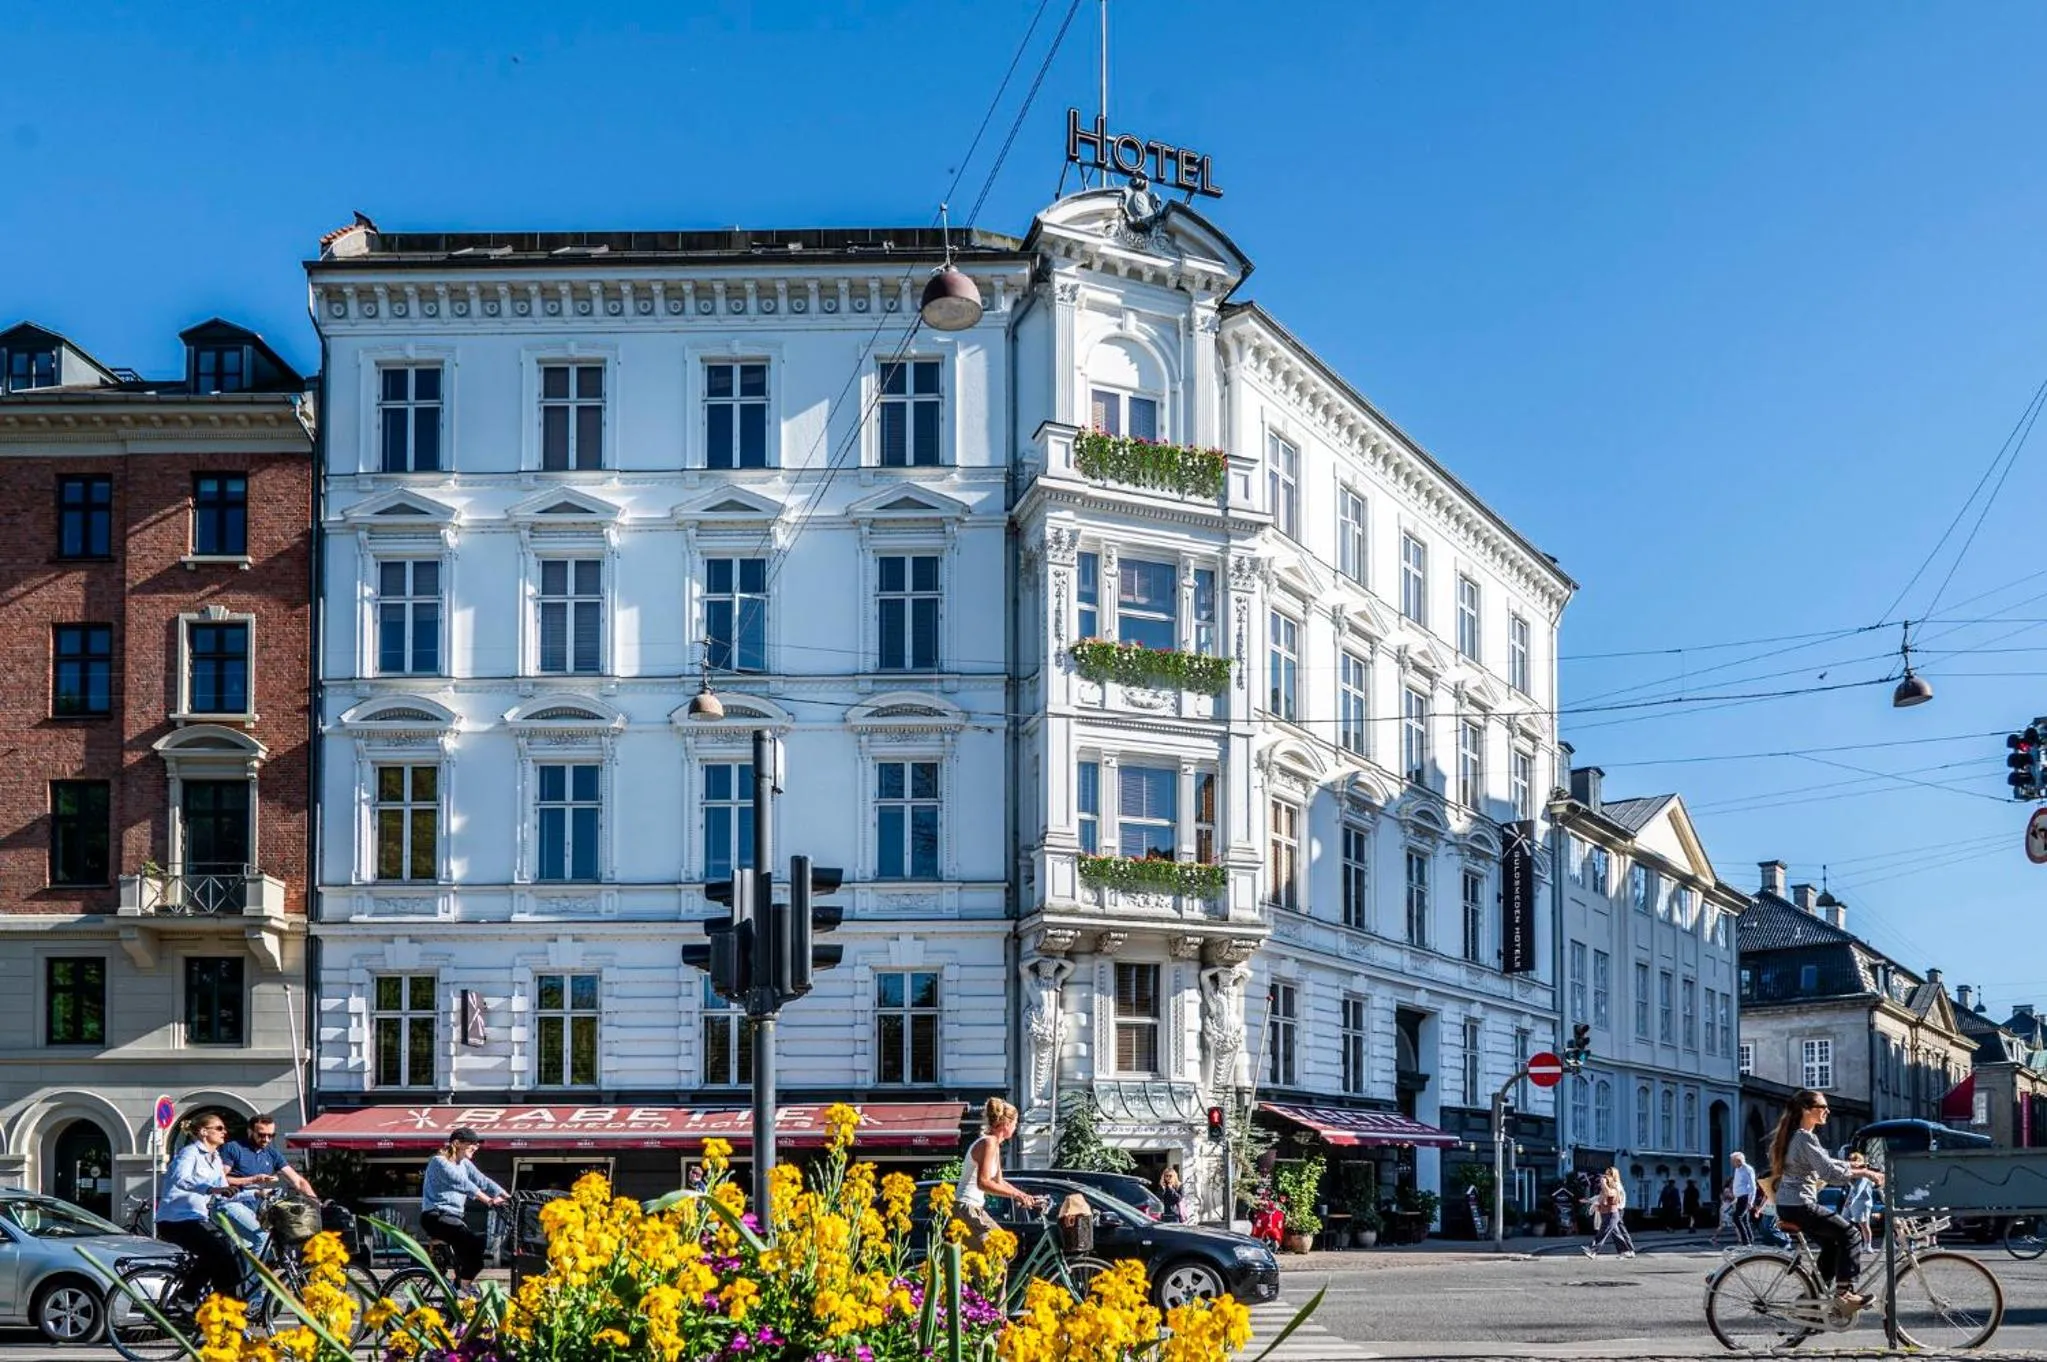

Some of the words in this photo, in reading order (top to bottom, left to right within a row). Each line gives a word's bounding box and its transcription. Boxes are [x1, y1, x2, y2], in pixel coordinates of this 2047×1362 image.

[1068, 108, 1223, 198] HOTEL
[1513, 927, 1522, 968] HOTELS
[685, 1120, 811, 1129] HOTLS
